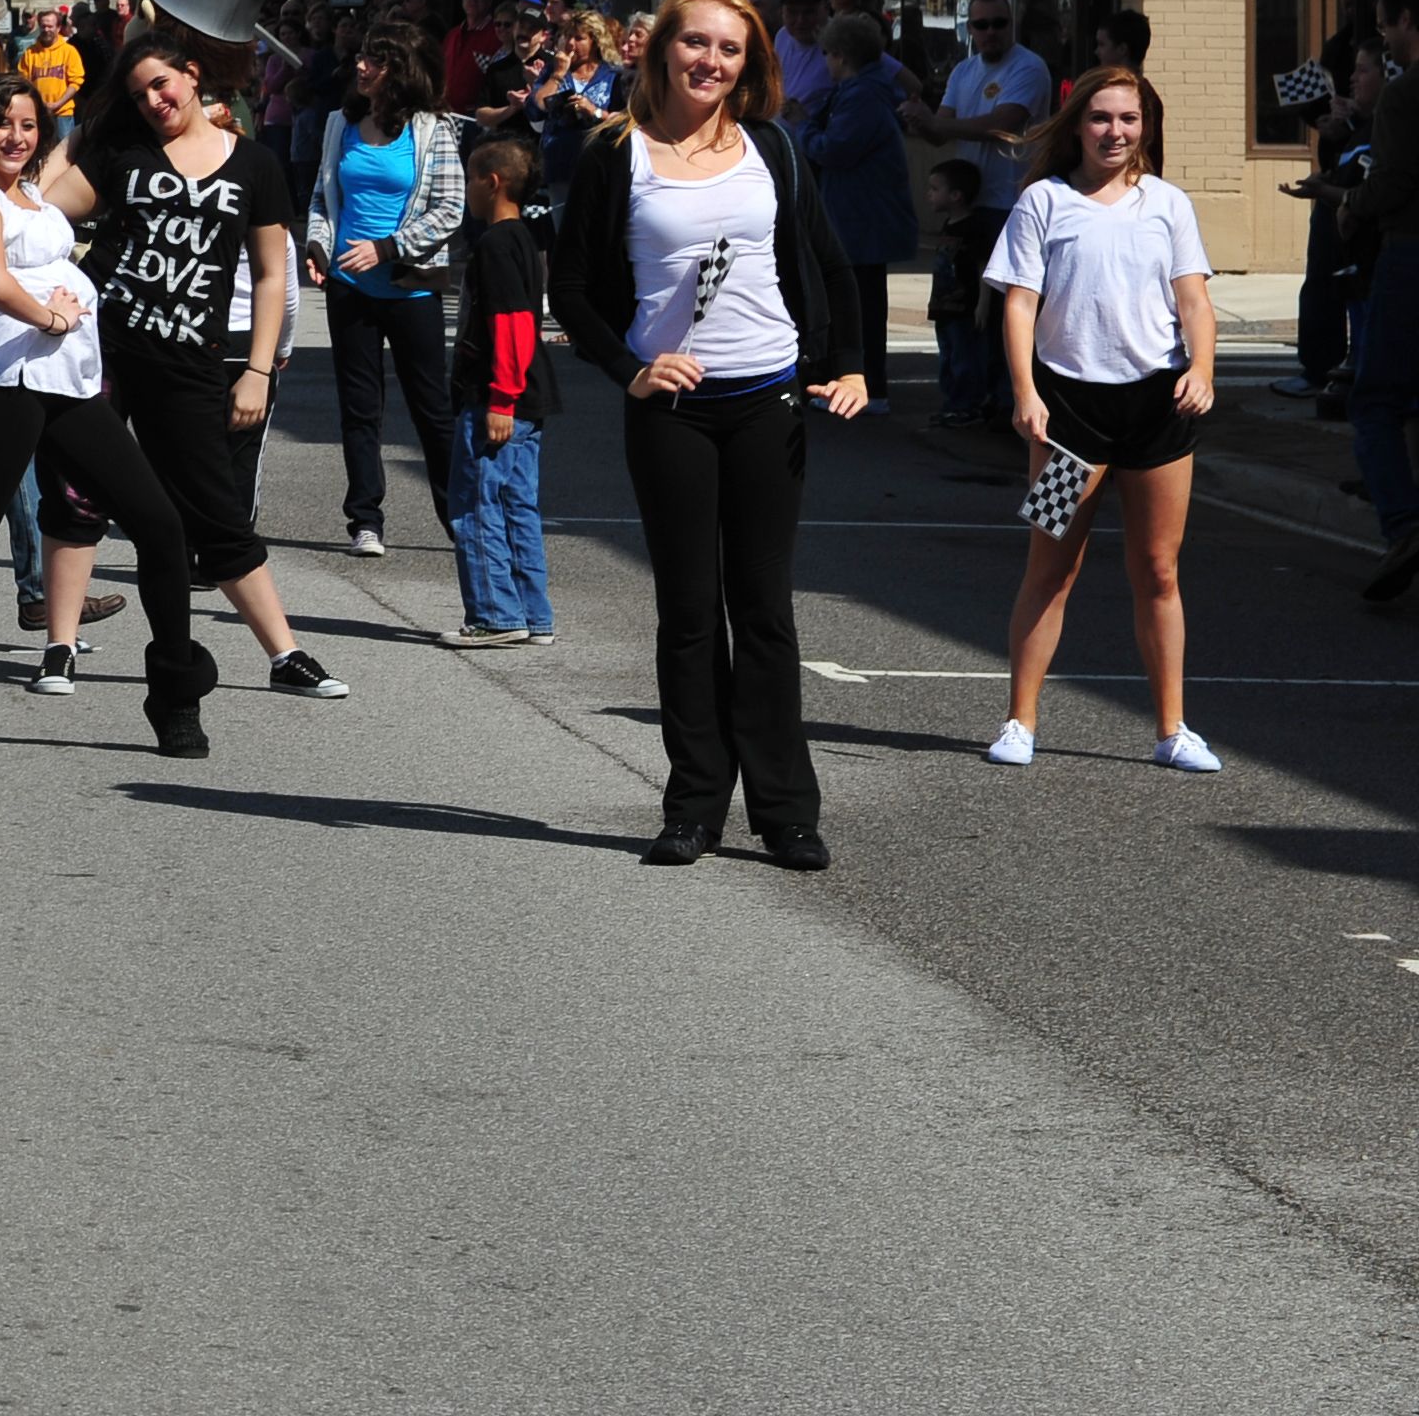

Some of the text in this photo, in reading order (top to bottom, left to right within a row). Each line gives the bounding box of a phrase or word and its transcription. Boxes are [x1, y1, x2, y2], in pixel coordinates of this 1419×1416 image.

[126, 168, 244, 216] LOVE
[138, 209, 222, 255] YOU
[115, 238, 223, 300] LOVE
[98, 276, 213, 346] PINK
